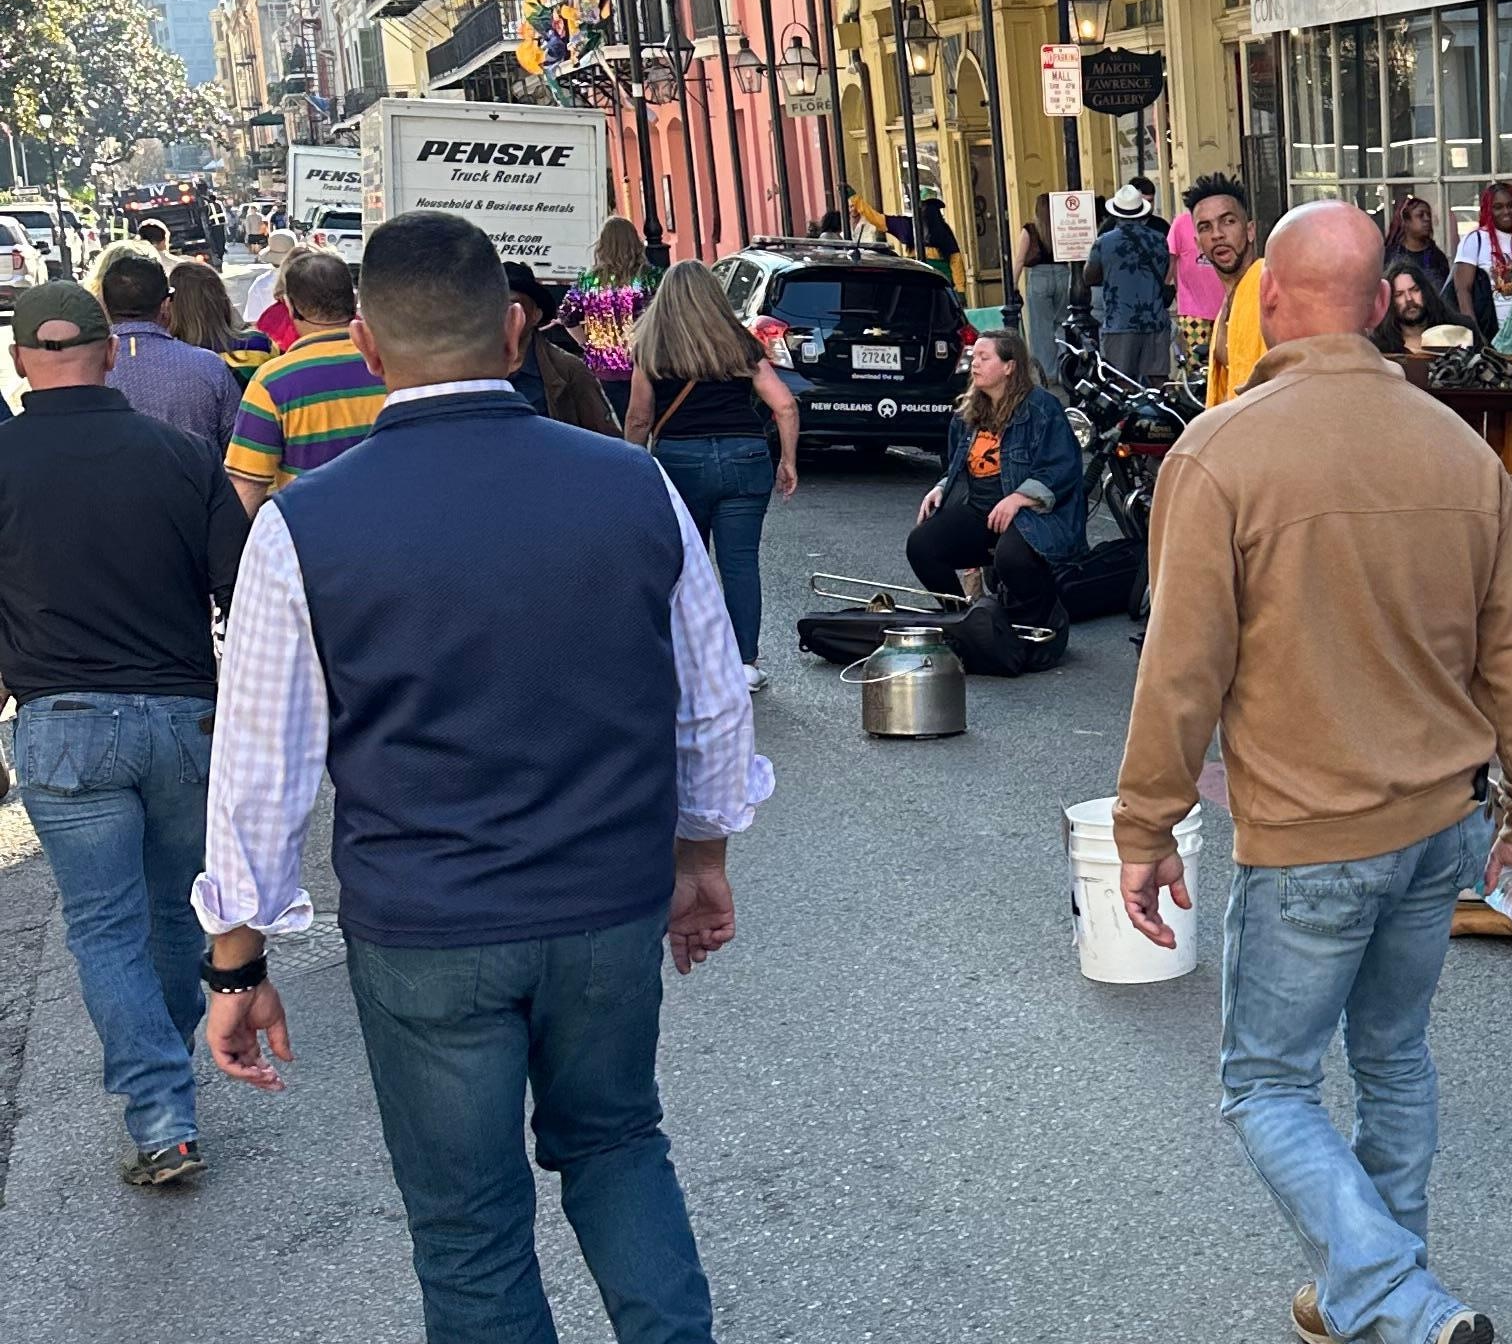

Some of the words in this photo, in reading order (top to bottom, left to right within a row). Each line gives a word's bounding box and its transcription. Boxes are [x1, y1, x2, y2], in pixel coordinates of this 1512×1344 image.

[1092, 62, 1141, 75] MARTIN
[1085, 77, 1153, 91] LAWRENCE
[1091, 94, 1146, 106] GALLERY
[416, 140, 574, 167] PENSKE
[305, 168, 362, 184] PENS
[451, 168, 490, 183] Truck
[493, 169, 542, 185] Rental
[416, 197, 474, 210] Household
[474, 199, 483, 210] &
[486, 200, 533, 212] Business
[535, 202, 575, 214] Rentals
[861, 351, 898, 365] 272424
[811, 402, 832, 411] NEW
[833, 402, 873, 412] ORLEANS
[901, 403, 931, 413] POLICE
[932, 404, 953, 413] DEPT
